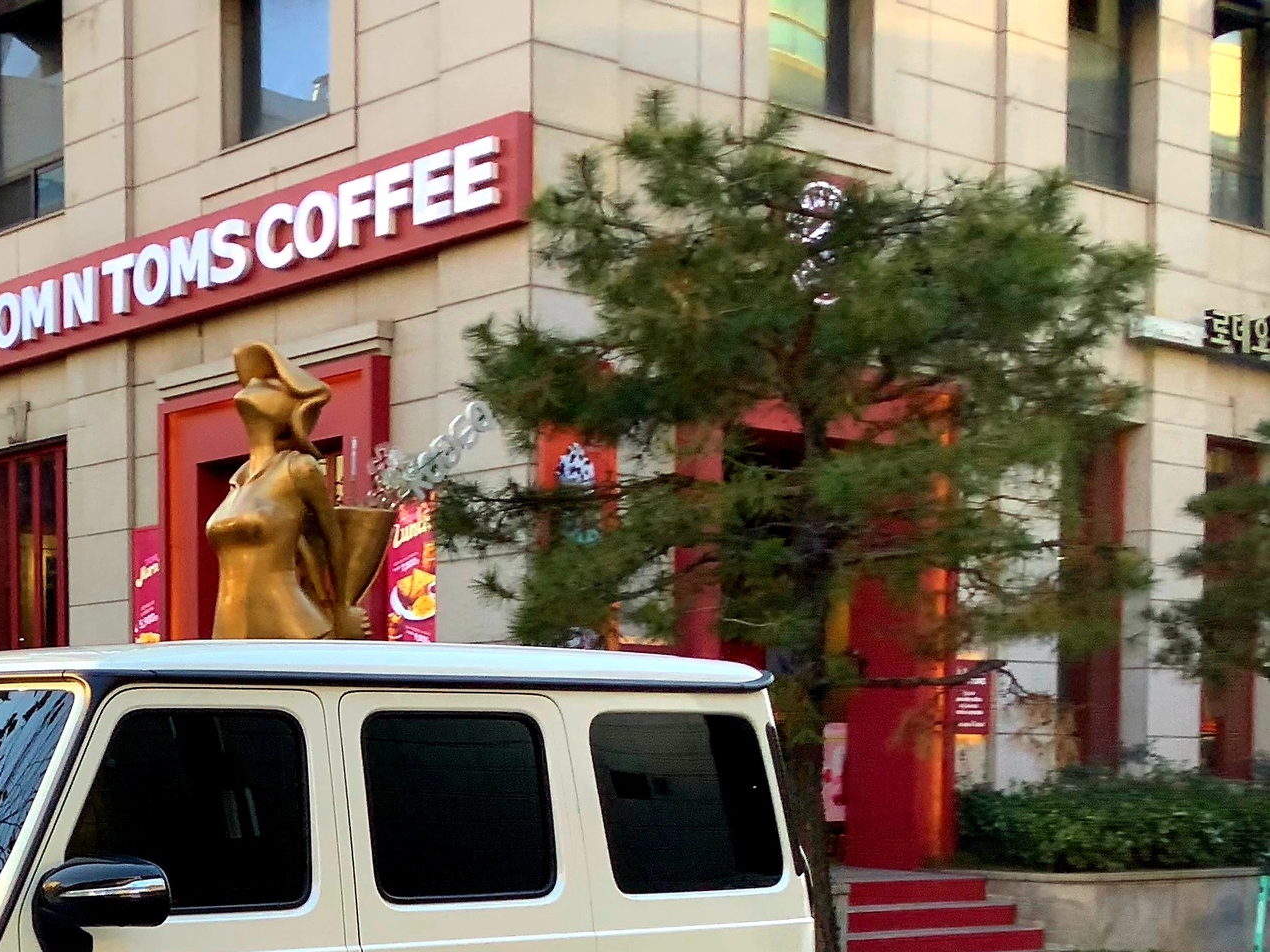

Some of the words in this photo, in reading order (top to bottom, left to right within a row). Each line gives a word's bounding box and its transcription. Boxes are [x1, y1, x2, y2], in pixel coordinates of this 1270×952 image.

[61, 263, 101, 330] N
[101, 218, 254, 313] TOMS
[254, 134, 502, 271] COFFEE
